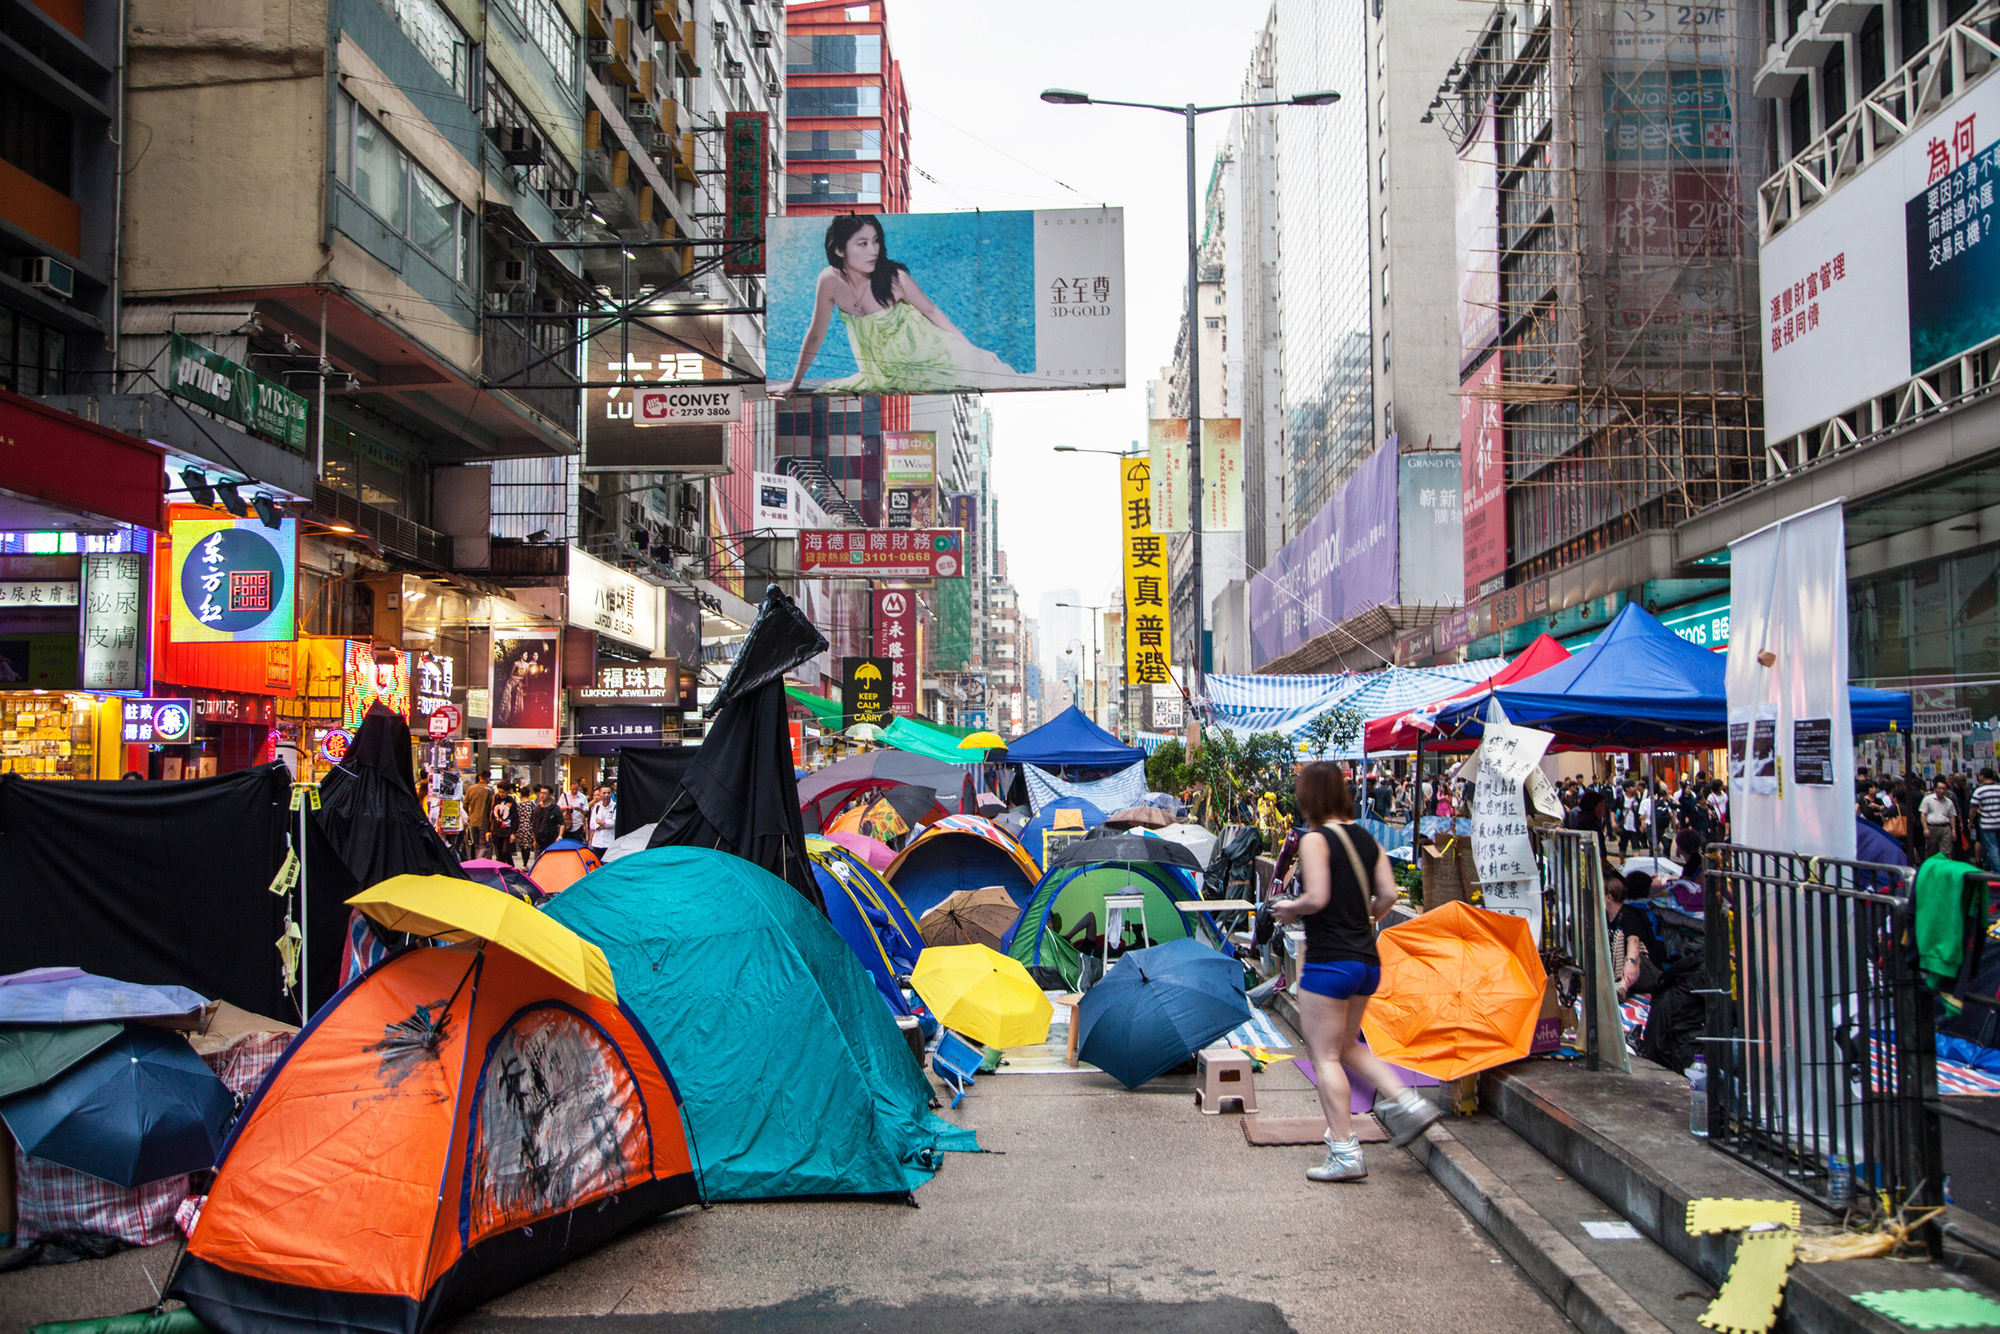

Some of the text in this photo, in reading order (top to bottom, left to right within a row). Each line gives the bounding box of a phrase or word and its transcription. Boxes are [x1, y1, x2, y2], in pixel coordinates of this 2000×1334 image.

[1926, 112, 1977, 187] 為何
[1929, 214, 1992, 271] 交易良機？
[1051, 276, 1110, 304] 金至尊
[1050, 305, 1110, 317] 3D-GOLD
[177, 355, 232, 402] prince
[258, 384, 289, 417] MRS
[669, 393, 730, 406] CONVEY
[707, 408, 730, 416] 3806
[1408, 458, 1443, 468] GRAND
[805, 533, 931, 550] 海德國際財務
[864, 552, 931, 562] 3101-0668
[1321, 529, 1341, 578] LOOK
[89, 556, 140, 580] 君健
[234, 575, 265, 585] TUNG
[234, 586, 265, 596] FONG
[1127, 497, 1168, 684] 我要真普選
[88, 592, 137, 615] 泌尿
[87, 625, 136, 649] 皮膚
[889, 620, 907, 698] 永隆銀行
[598, 667, 667, 689] 福珠寶
[581, 689, 666, 698] LUKFOOK JEWELLERY
[590, 726, 619, 734] TSL
[1536, 1023, 1558, 1041] vita
